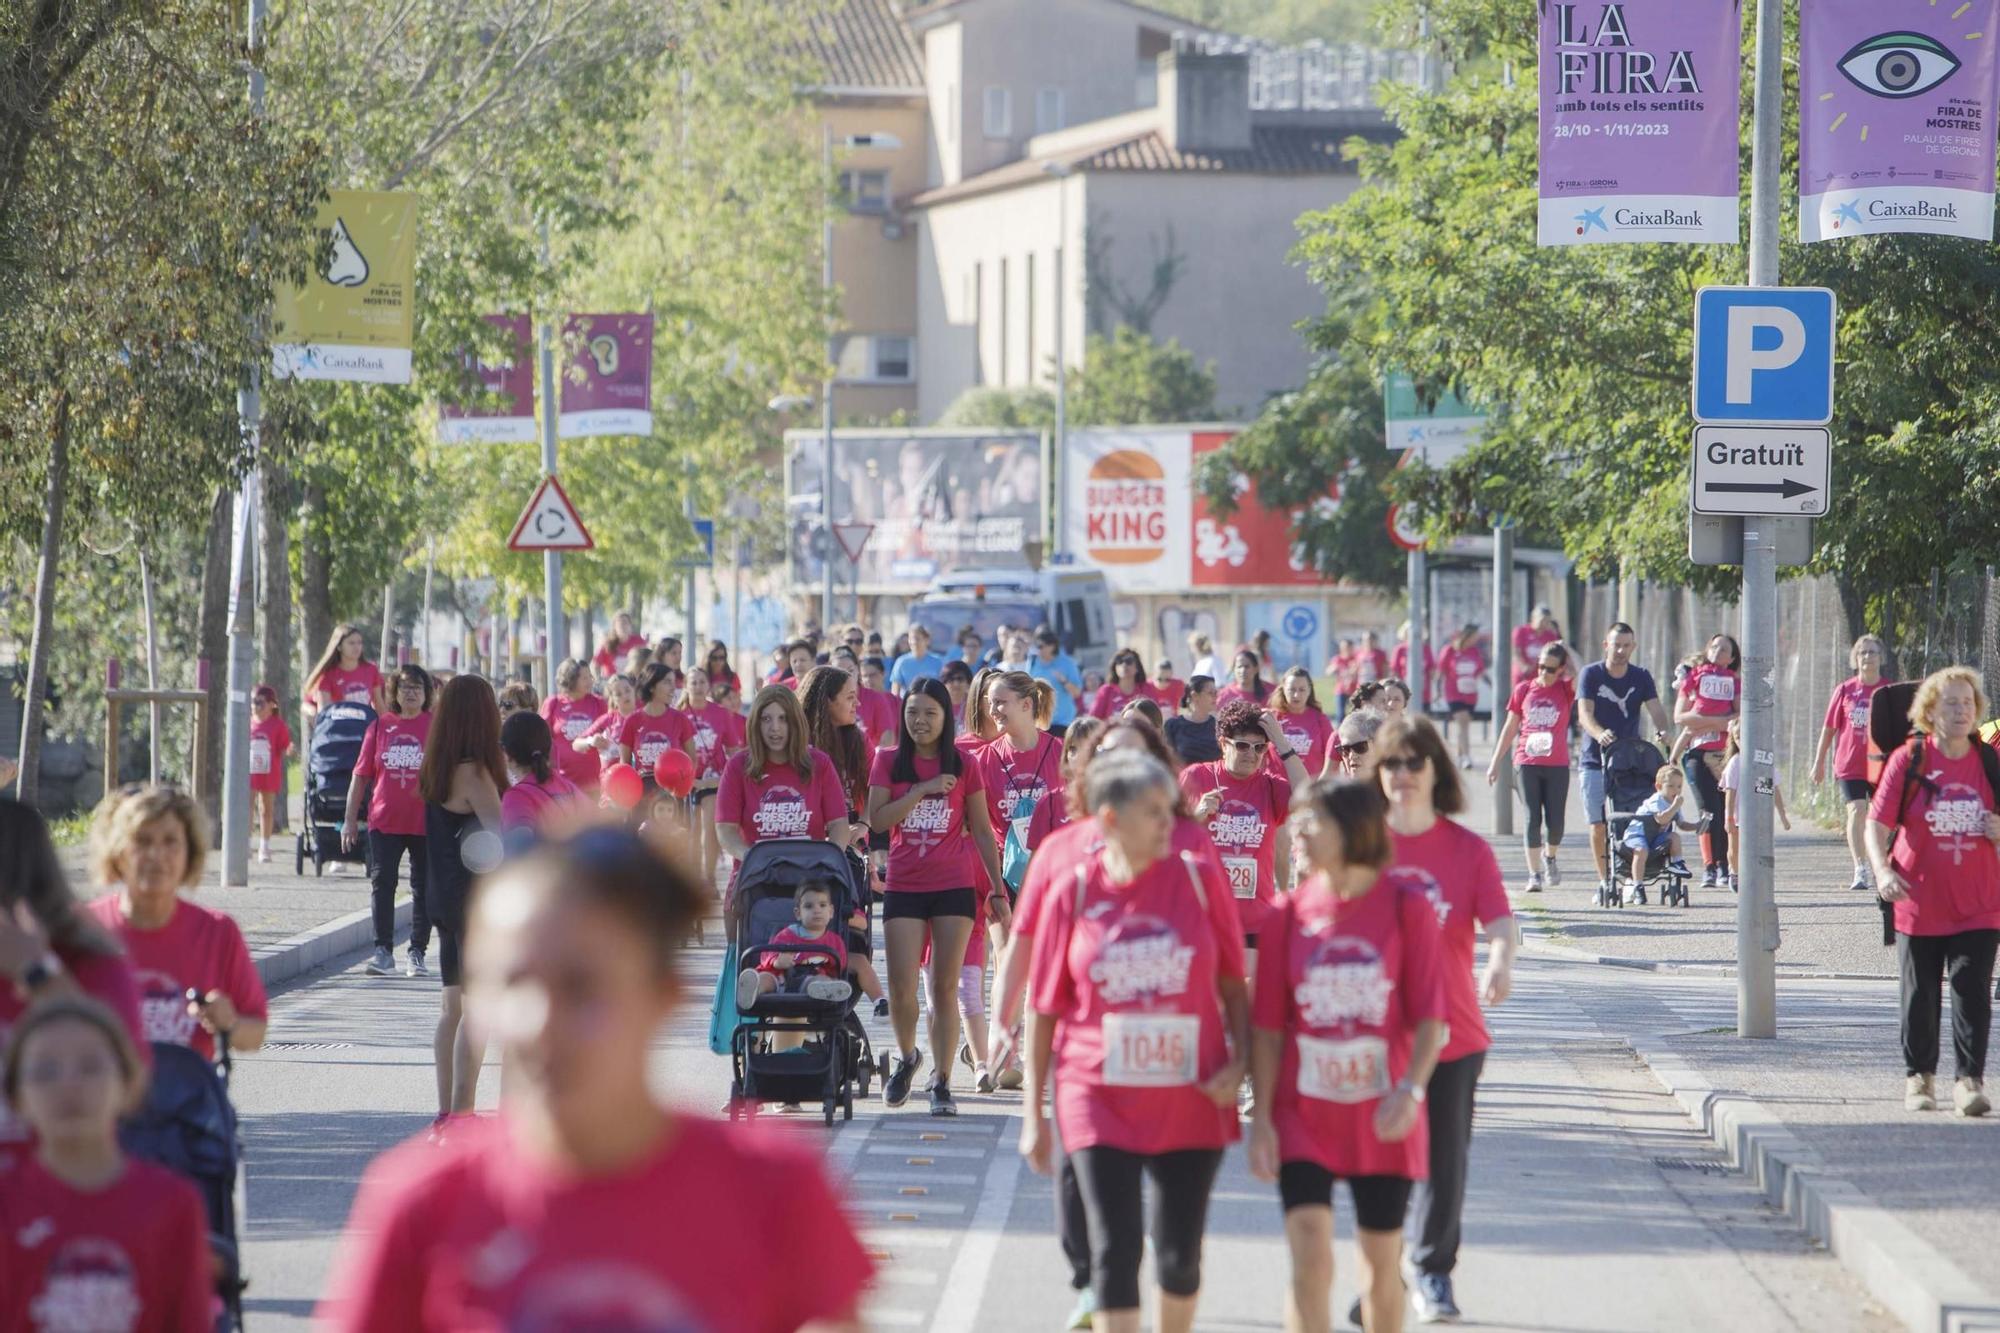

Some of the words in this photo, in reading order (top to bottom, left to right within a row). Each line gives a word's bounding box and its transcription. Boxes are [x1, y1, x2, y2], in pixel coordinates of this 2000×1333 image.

[1556, 4, 1634, 47] LA
[1555, 51, 1703, 95] FIRA
[1555, 100, 1587, 113] amb
[1590, 100, 1620, 112] tots
[1624, 100, 1647, 112] els
[1650, 99, 1704, 112] sentits
[1937, 106, 1965, 117] FIRA
[1967, 107, 1982, 119] DE
[1554, 124, 1591, 138] 28/10
[1603, 123, 1669, 137] 1/11/2023
[1926, 118, 1981, 131] MOSTRES
[1903, 134, 1937, 144] PALAU
[1939, 135, 1953, 144] DE
[1955, 136, 1981, 148] FIRES
[1925, 145, 1940, 154] DE
[1942, 146, 1981, 157] GIRONA
[1868, 200, 1957, 219] CaixaBank
[1615, 208, 1703, 226] CaixaBank
[323, 353, 385, 370] CaixaBank
[1725, 305, 1806, 405] P
[1706, 441, 1804, 466] Gratuït
[1087, 486, 1166, 506] BURGER
[1087, 511, 1166, 540] KING
[764, 802, 801, 813] #HEM
[914, 798, 944, 811] HEM
[752, 811, 813, 823] CRESCUT
[900, 818, 950, 830] JUNTES
[1220, 814, 1256, 825] #HEM
[756, 822, 809, 833] JUNTES
[1207, 821, 1268, 834] CRESCUT
[1211, 832, 1264, 843] JUNTES
[1121, 1033, 1186, 1068] 1046
